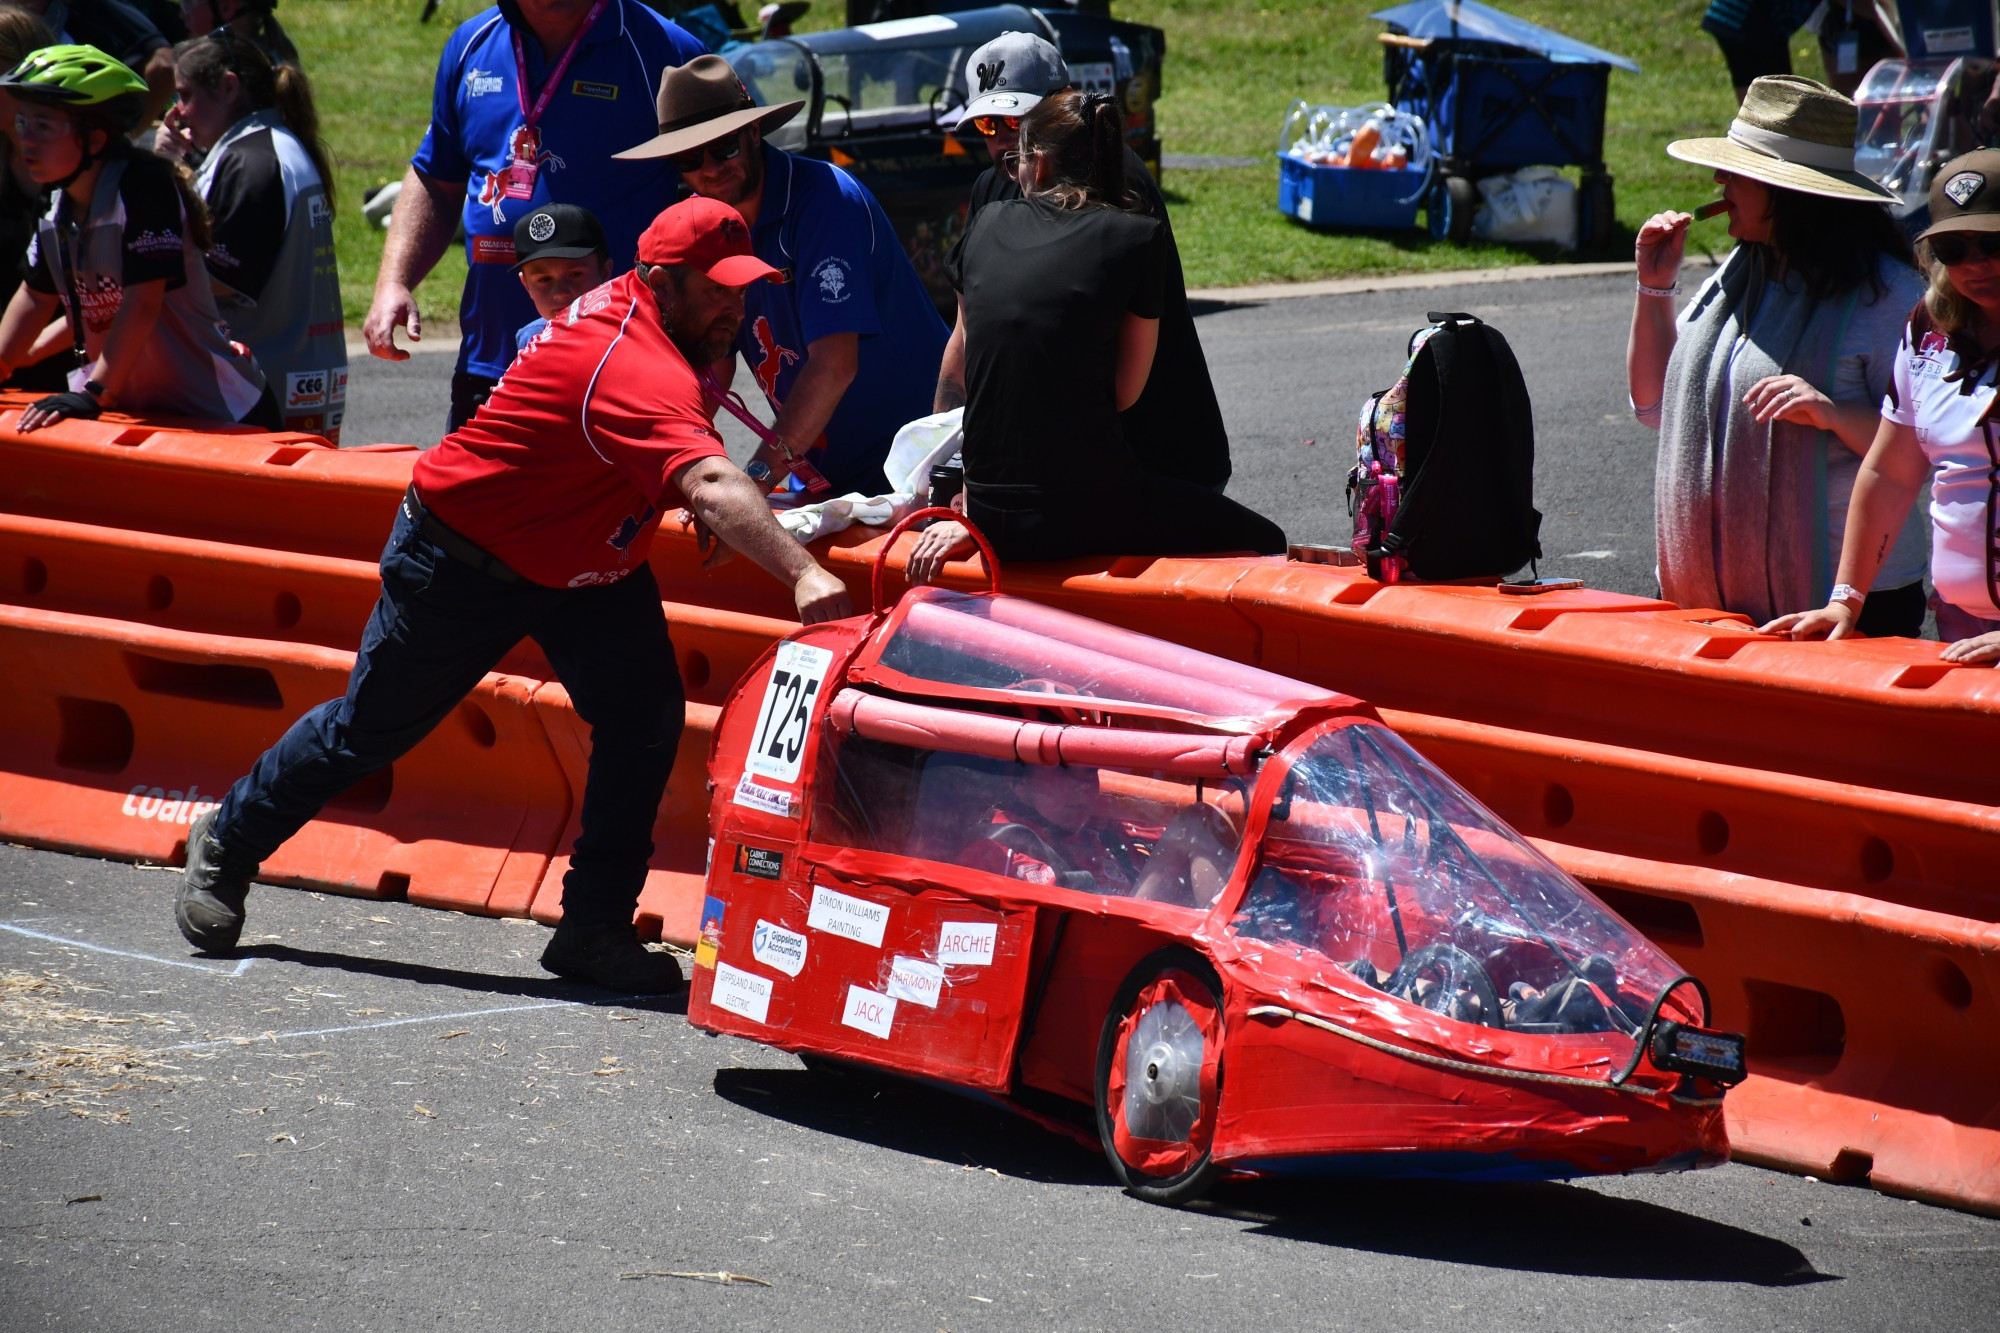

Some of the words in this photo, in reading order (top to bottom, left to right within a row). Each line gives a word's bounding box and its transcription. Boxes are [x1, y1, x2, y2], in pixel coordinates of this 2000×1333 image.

[513, 182, 527, 190] 2022
[479, 240, 510, 249] COLMAC
[296, 379, 323, 394] CEG
[758, 669, 819, 764] T25
[818, 894, 843, 911] SIMON
[845, 902, 881, 923] WILLIAMS
[827, 917, 862, 938] PAINTING
[771, 930, 803, 948] Gippsland
[942, 934, 993, 954] ARCHIE
[766, 953, 799, 968] SOLUTIONS
[767, 941, 802, 961] Accounting
[720, 970, 749, 990] GIPPSLAND
[748, 981, 766, 996] AUTO
[891, 969, 939, 993] HARMONY
[725, 993, 751, 1012] ELECTRIC
[853, 1000, 885, 1025] JACK
